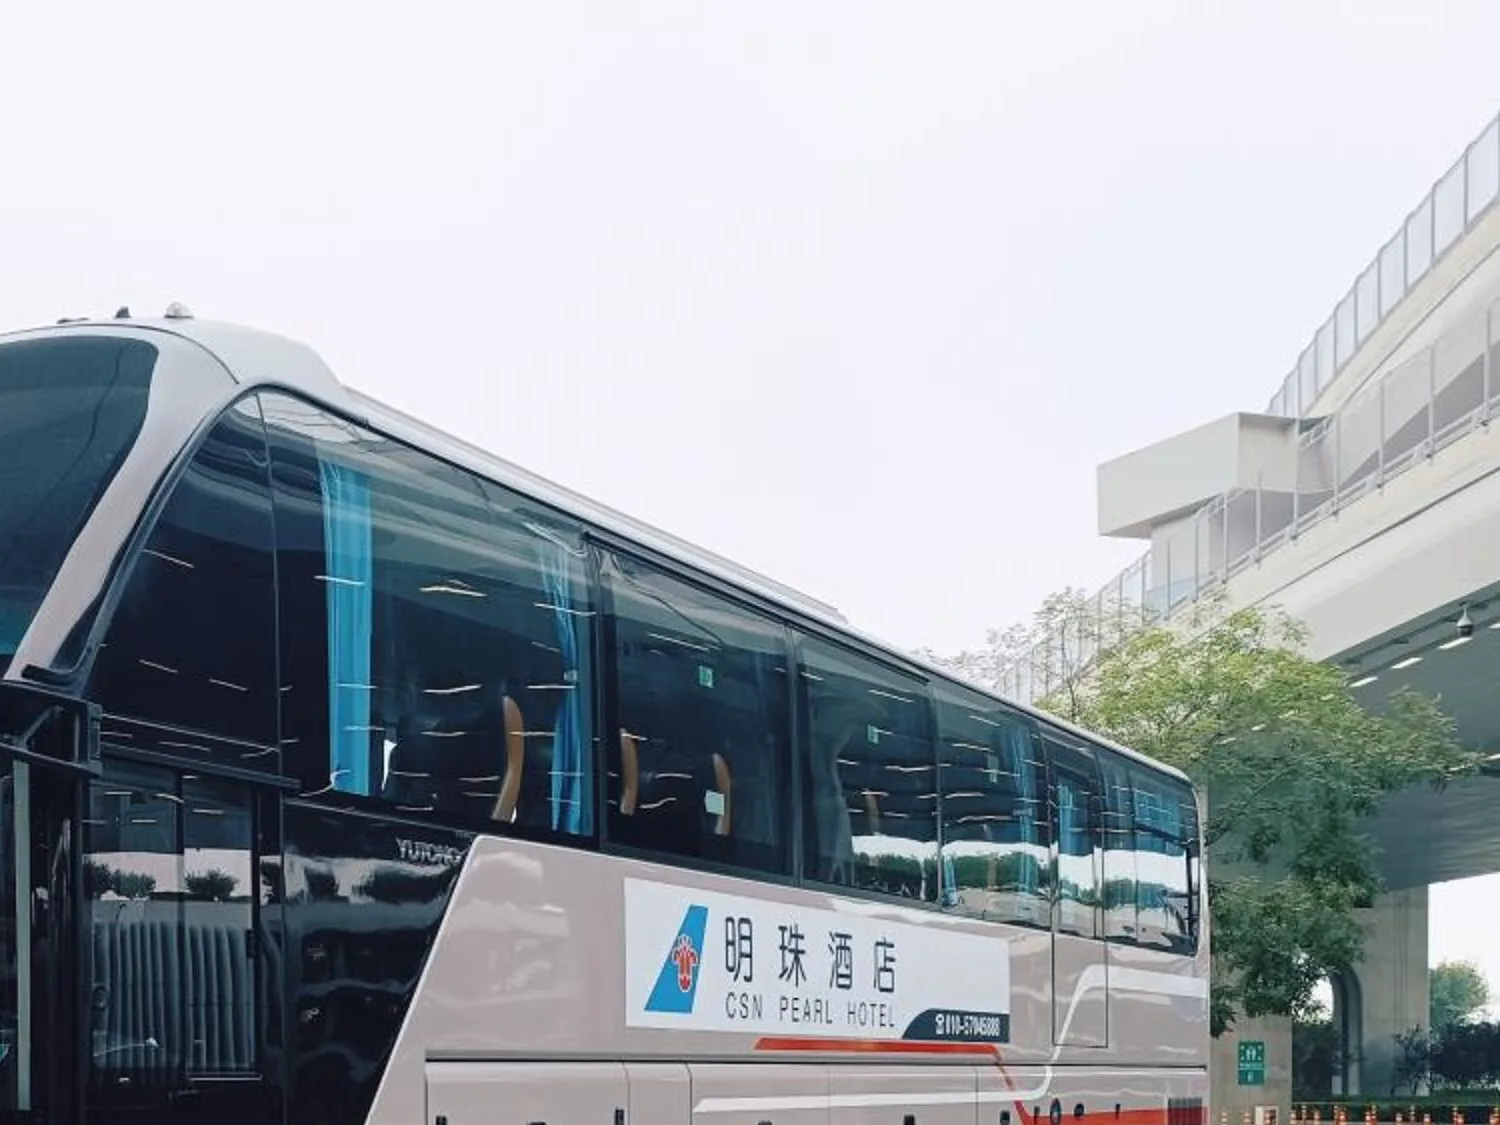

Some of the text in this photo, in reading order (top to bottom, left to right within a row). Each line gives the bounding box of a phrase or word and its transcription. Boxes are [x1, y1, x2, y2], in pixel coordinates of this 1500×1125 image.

[724, 915, 897, 994] 明珠酒店
[725, 992, 896, 1029] CSN PEARL HOTEL
